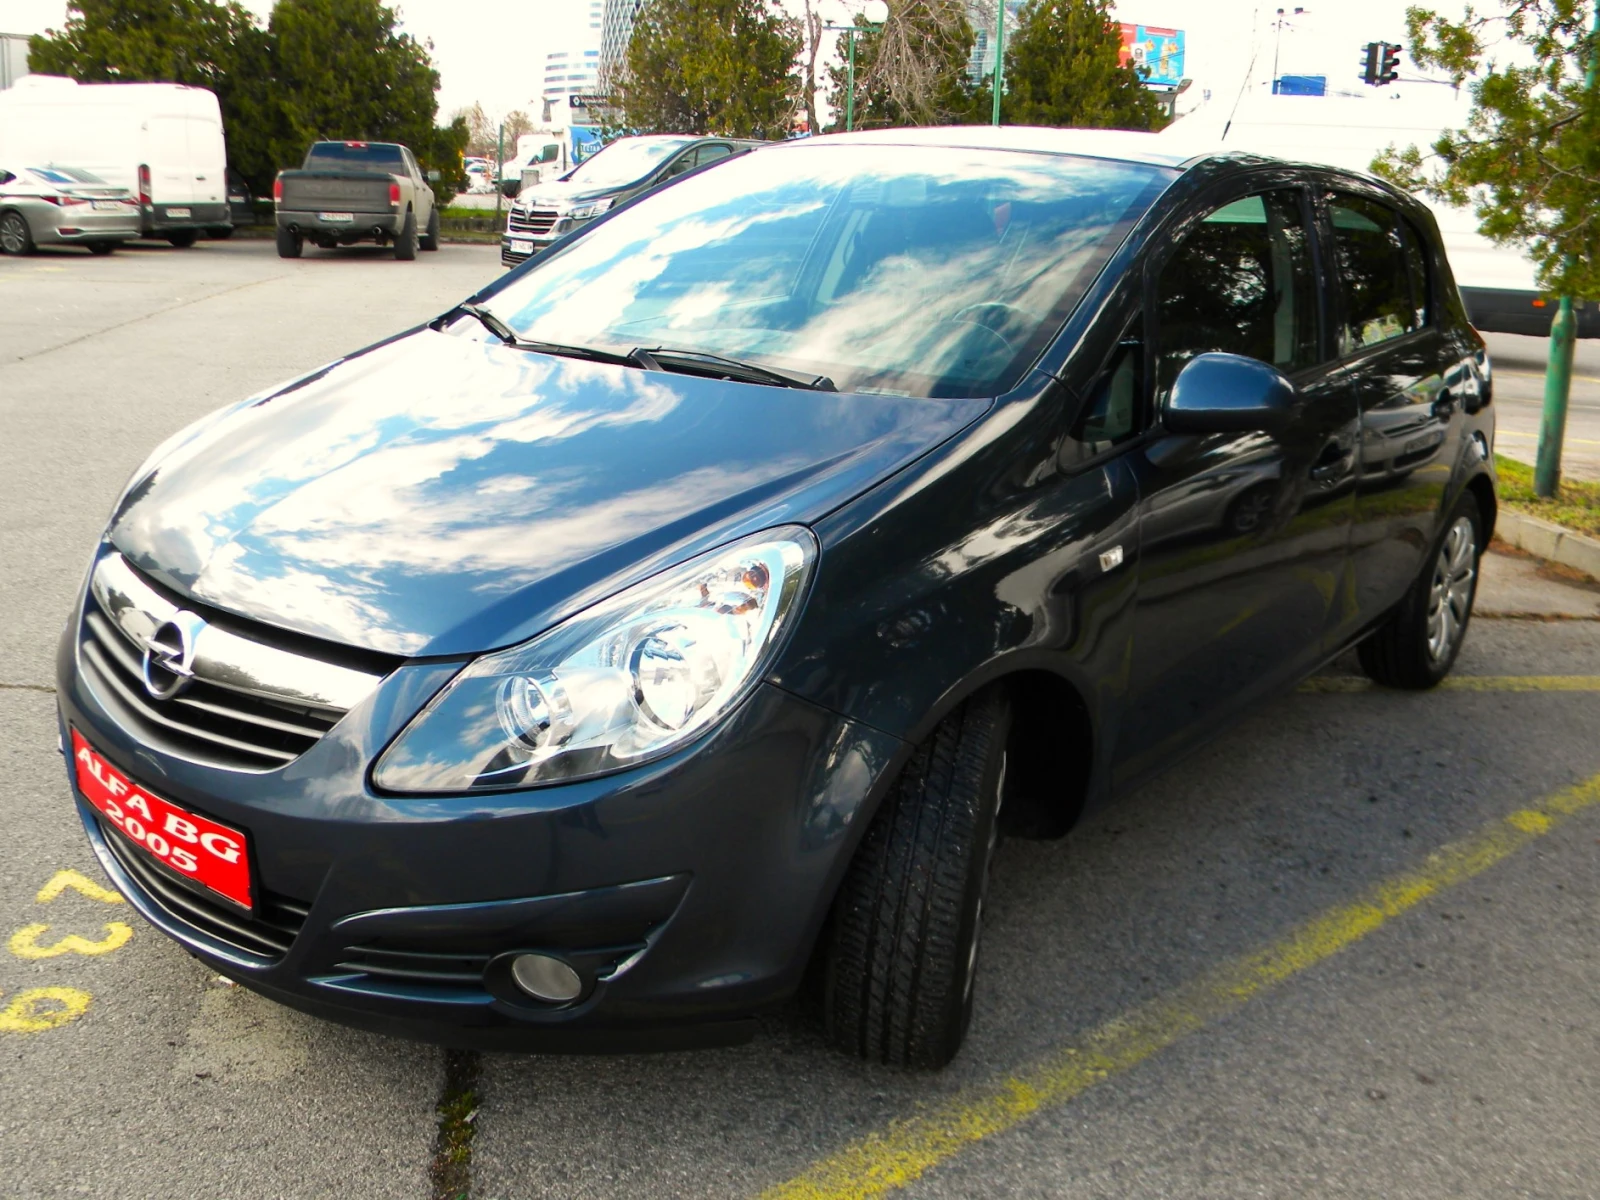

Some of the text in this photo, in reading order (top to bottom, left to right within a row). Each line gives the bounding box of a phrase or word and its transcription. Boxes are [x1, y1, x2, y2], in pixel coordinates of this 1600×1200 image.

[77, 747, 241, 864] ALFA BG
[105, 799, 198, 872] 2005
